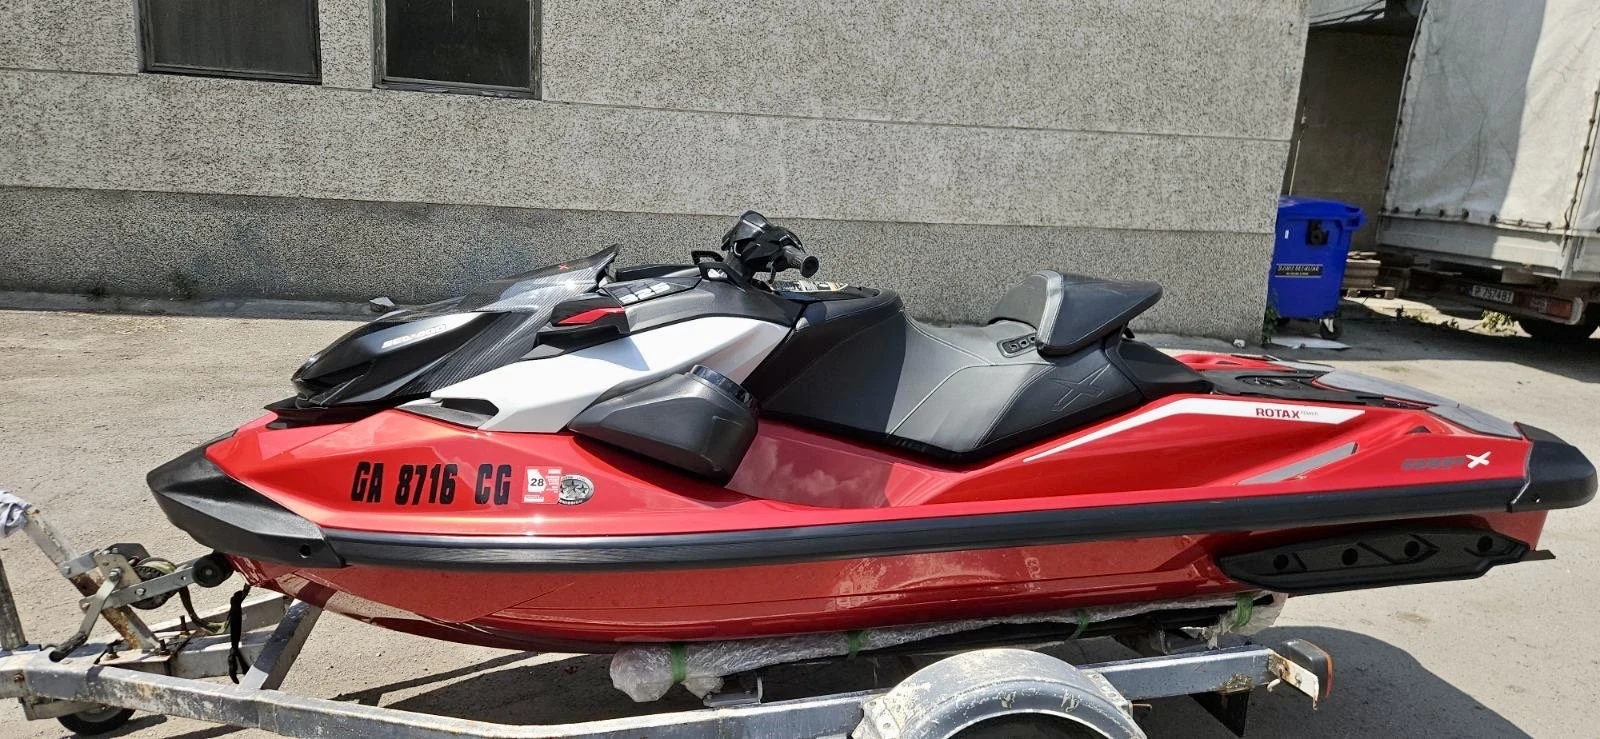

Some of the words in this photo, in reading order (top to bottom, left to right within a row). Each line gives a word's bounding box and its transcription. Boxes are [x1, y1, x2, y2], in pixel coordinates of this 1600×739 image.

[1255, 407, 1301, 419] ROTAX
[350, 461, 385, 504] GA
[395, 463, 459, 506] 8716
[474, 463, 513, 505] CG
[530, 478, 544, 487] 28
